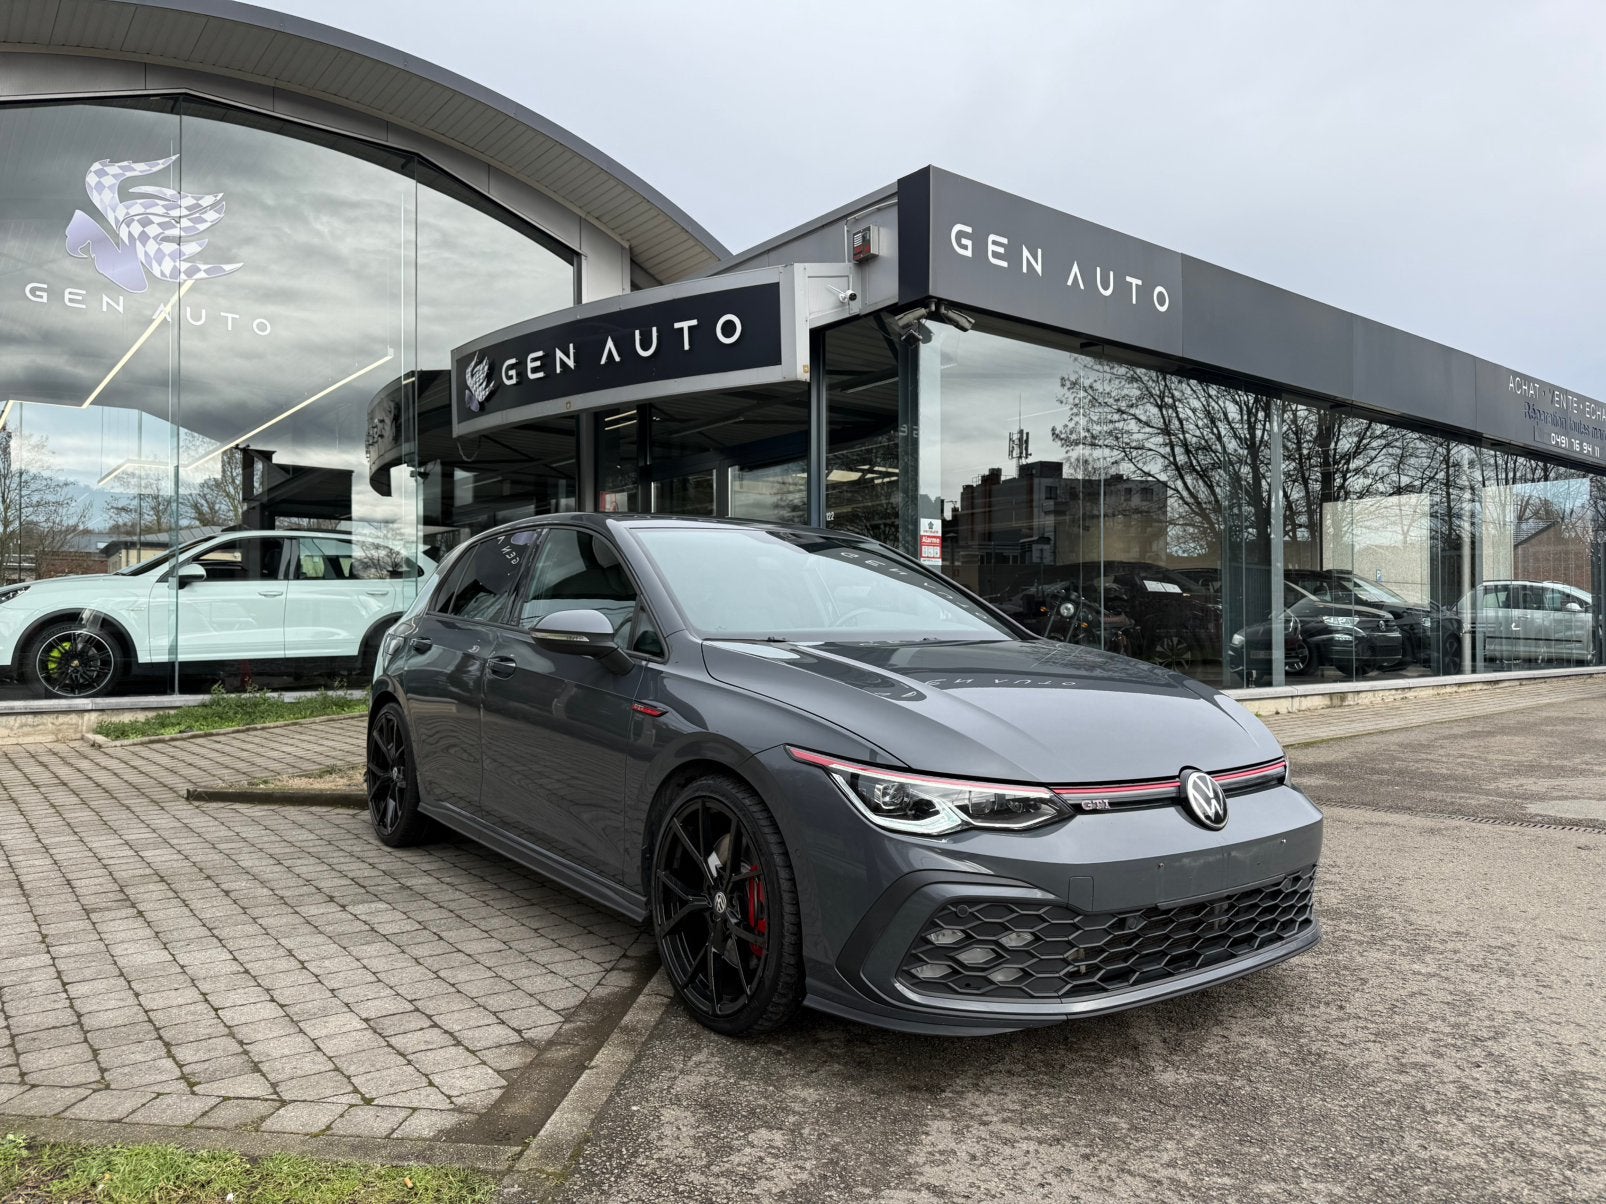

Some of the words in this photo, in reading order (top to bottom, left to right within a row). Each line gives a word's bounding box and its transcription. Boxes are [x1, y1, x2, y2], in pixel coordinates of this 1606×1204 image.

[950, 223, 1042, 277] GEN
[1066, 260, 1170, 313] AUTO
[24, 282, 124, 314] GEN
[152, 303, 271, 336] AUTO
[501, 343, 577, 386] GEN
[600, 313, 743, 365] AUTO
[1508, 375, 1540, 400] ACHAT
[1551, 432, 1569, 449] 0491
[1571, 438, 1580, 452] 76
[1582, 442, 1593, 456] 94
[1081, 799, 1111, 811] GTI
